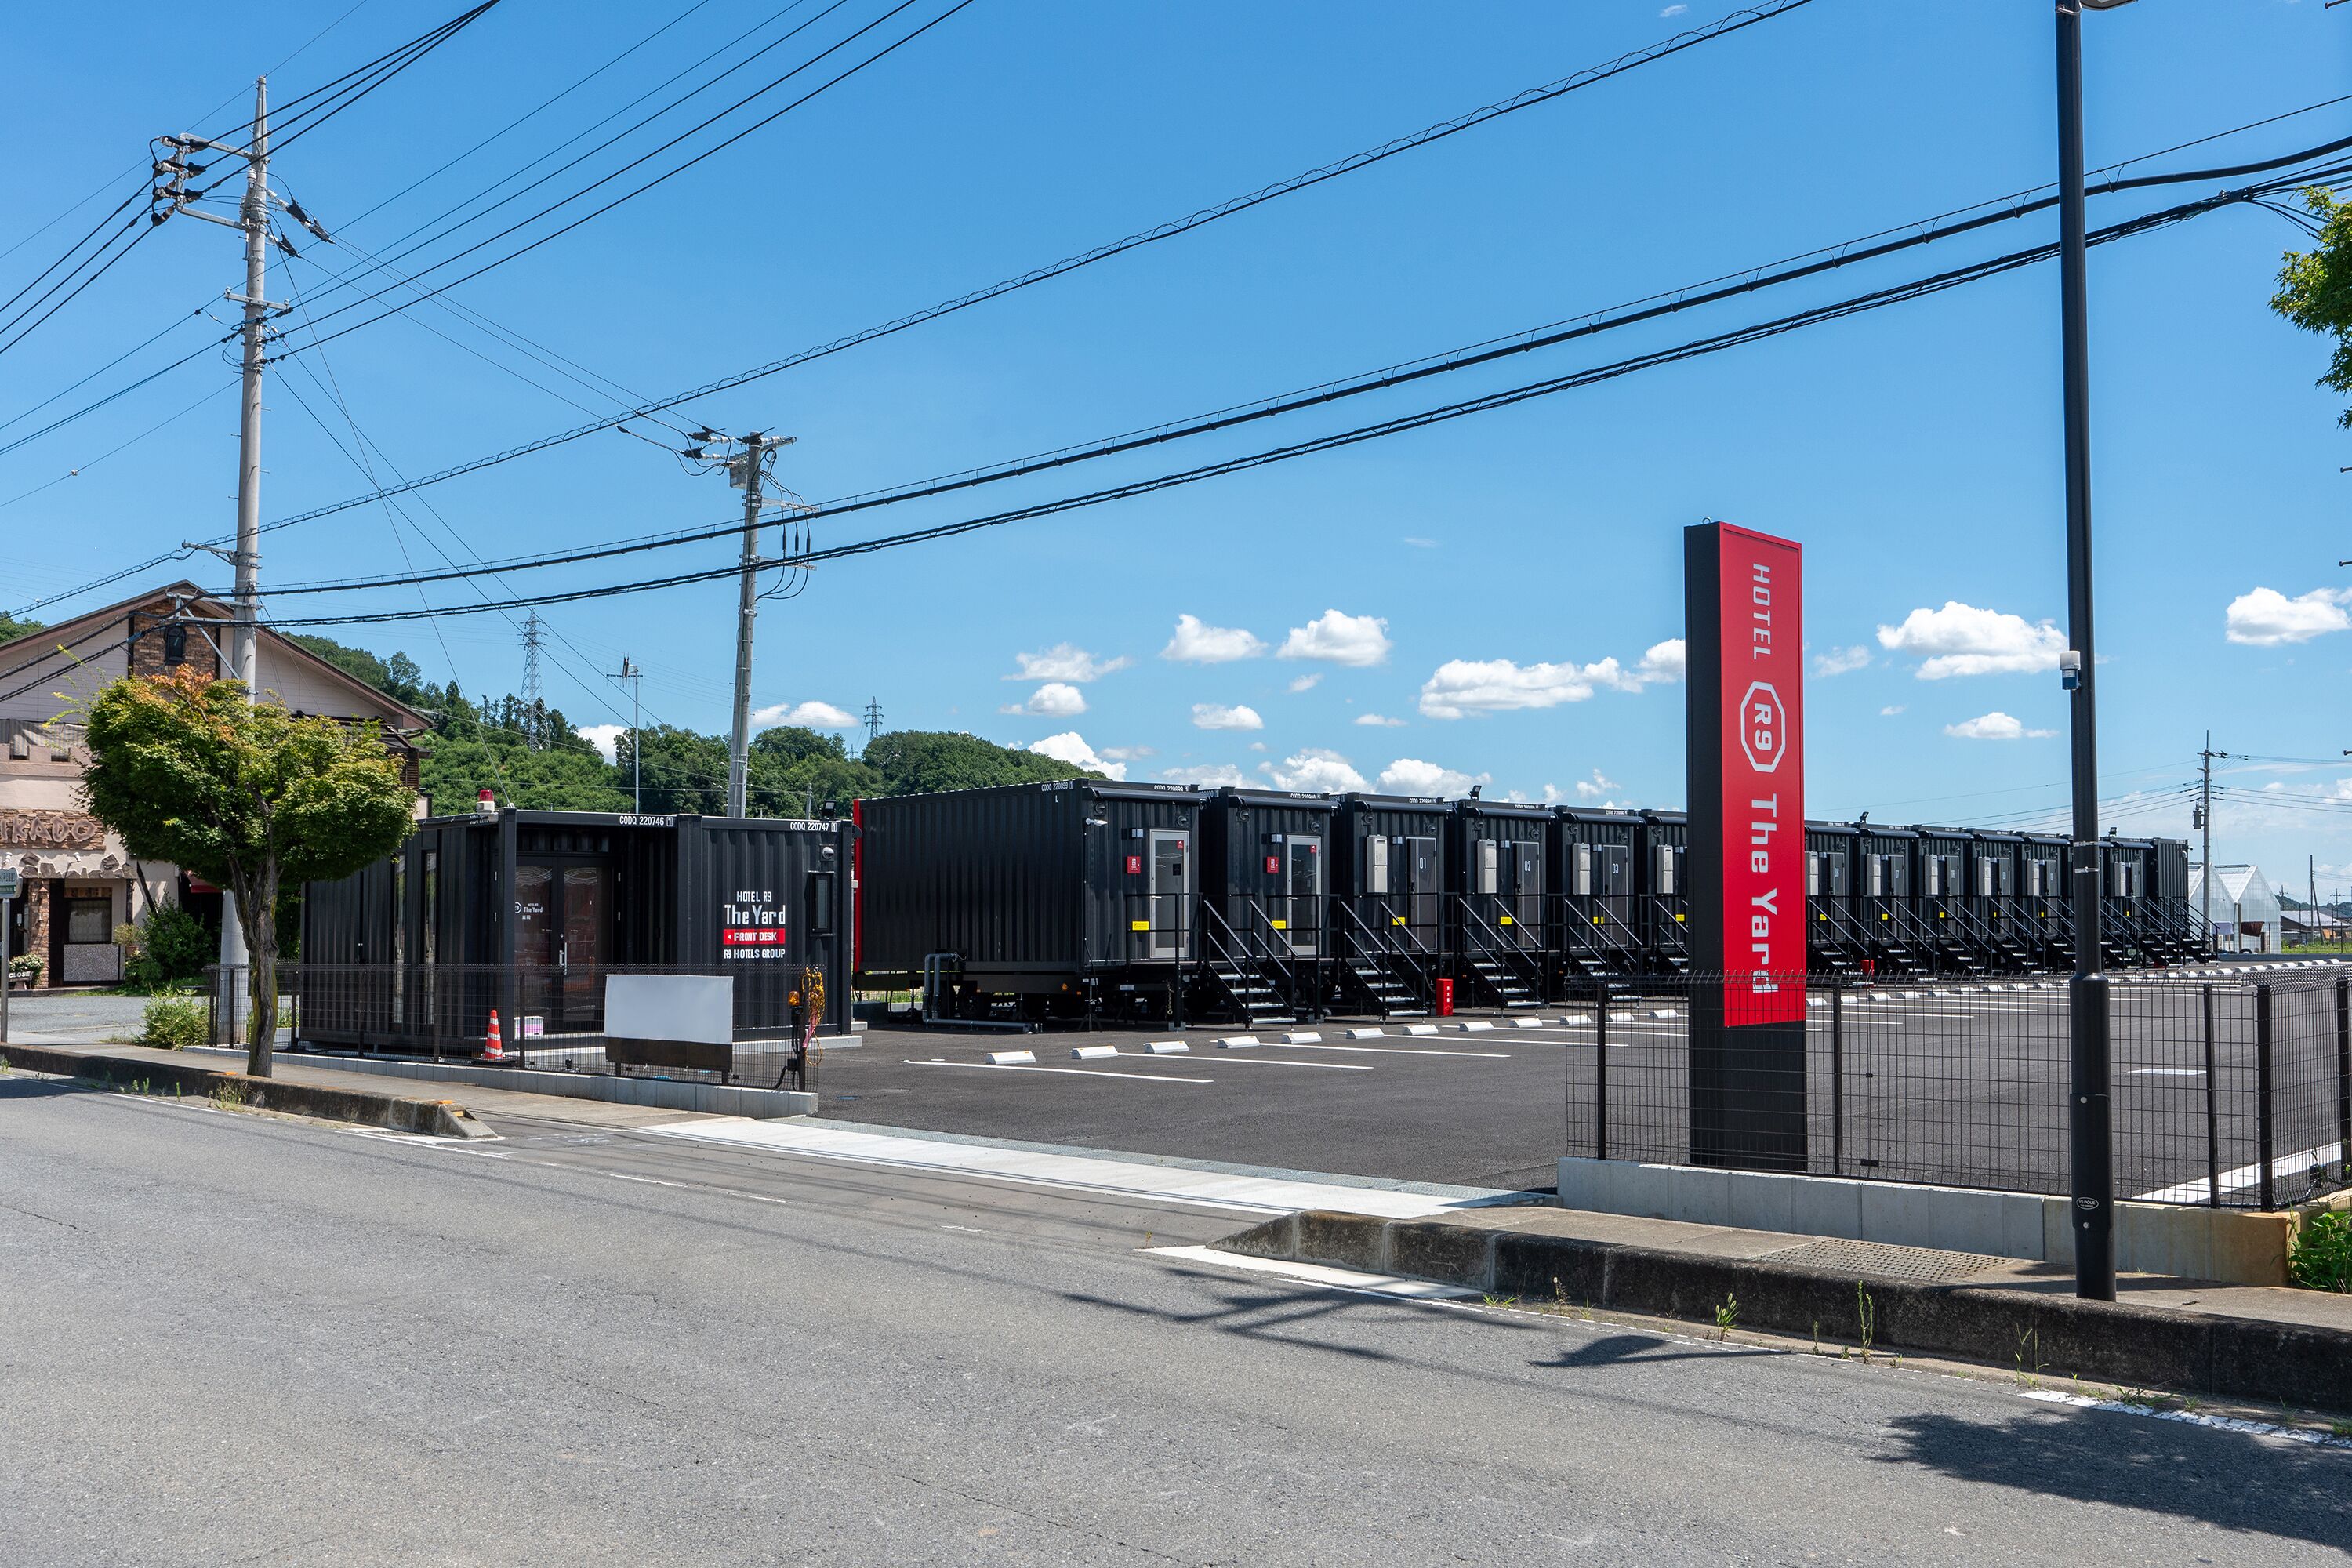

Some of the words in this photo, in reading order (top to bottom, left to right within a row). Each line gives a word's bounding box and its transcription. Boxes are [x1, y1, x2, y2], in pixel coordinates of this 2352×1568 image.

[1753, 563, 1771, 660] HOTEL
[1754, 702, 1773, 751] R9
[619, 816, 637, 825] CODQ
[639, 816, 664, 826] 220746
[790, 822, 805, 830] CODQ
[808, 822, 829, 831] 220747
[1751, 793, 1777, 873] The
[1420, 858, 1426, 869] 01
[1525, 861, 1530, 871] 02
[1613, 863, 1618, 873] 03
[737, 891, 760, 902] HOTEL
[764, 891, 771, 902] R9
[724, 905, 749, 924] The
[752, 905, 786, 924] Yard
[734, 932, 757, 941] FRONT
[759, 932, 777, 941] DESK
[1751, 887, 1778, 993] Yard
[724, 949, 732, 959] R9
[734, 949, 760, 959] HOTELS
[762, 949, 786, 959] GROUP
